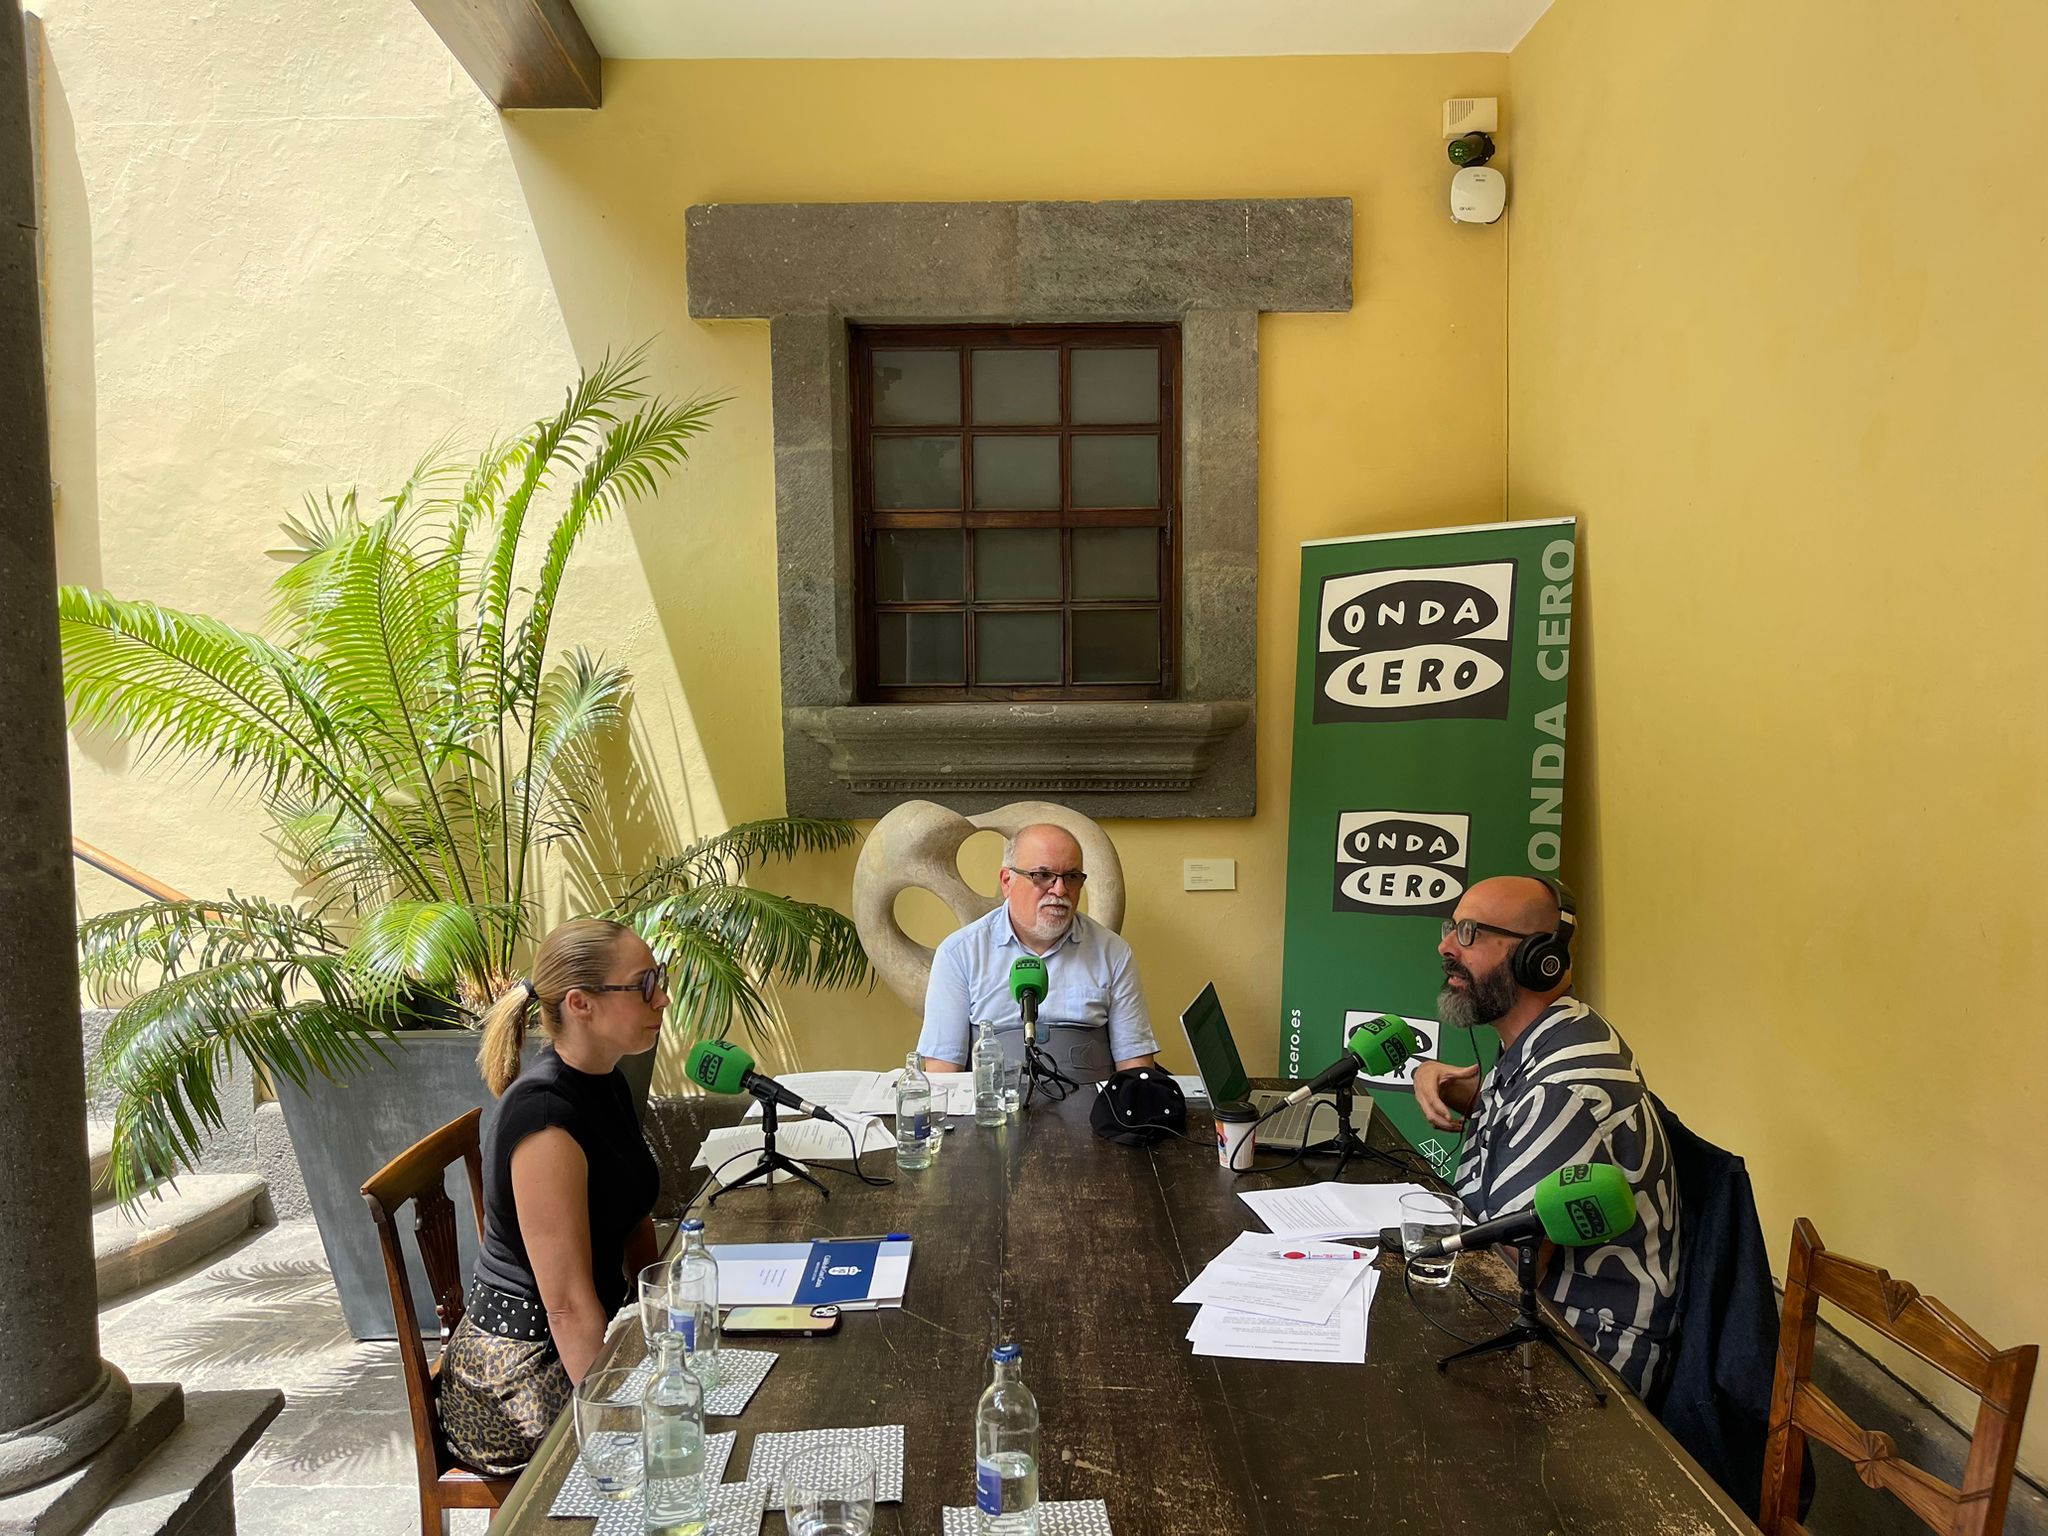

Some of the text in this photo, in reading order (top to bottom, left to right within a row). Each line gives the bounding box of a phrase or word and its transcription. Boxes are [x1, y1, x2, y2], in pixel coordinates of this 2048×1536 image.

[1343, 597, 1480, 634] ONDA
[1347, 658, 1478, 695] CERO
[1527, 539, 1575, 872] ONDA CERO
[1354, 832, 1448, 855] ONDA
[1357, 872, 1446, 898] CERO
